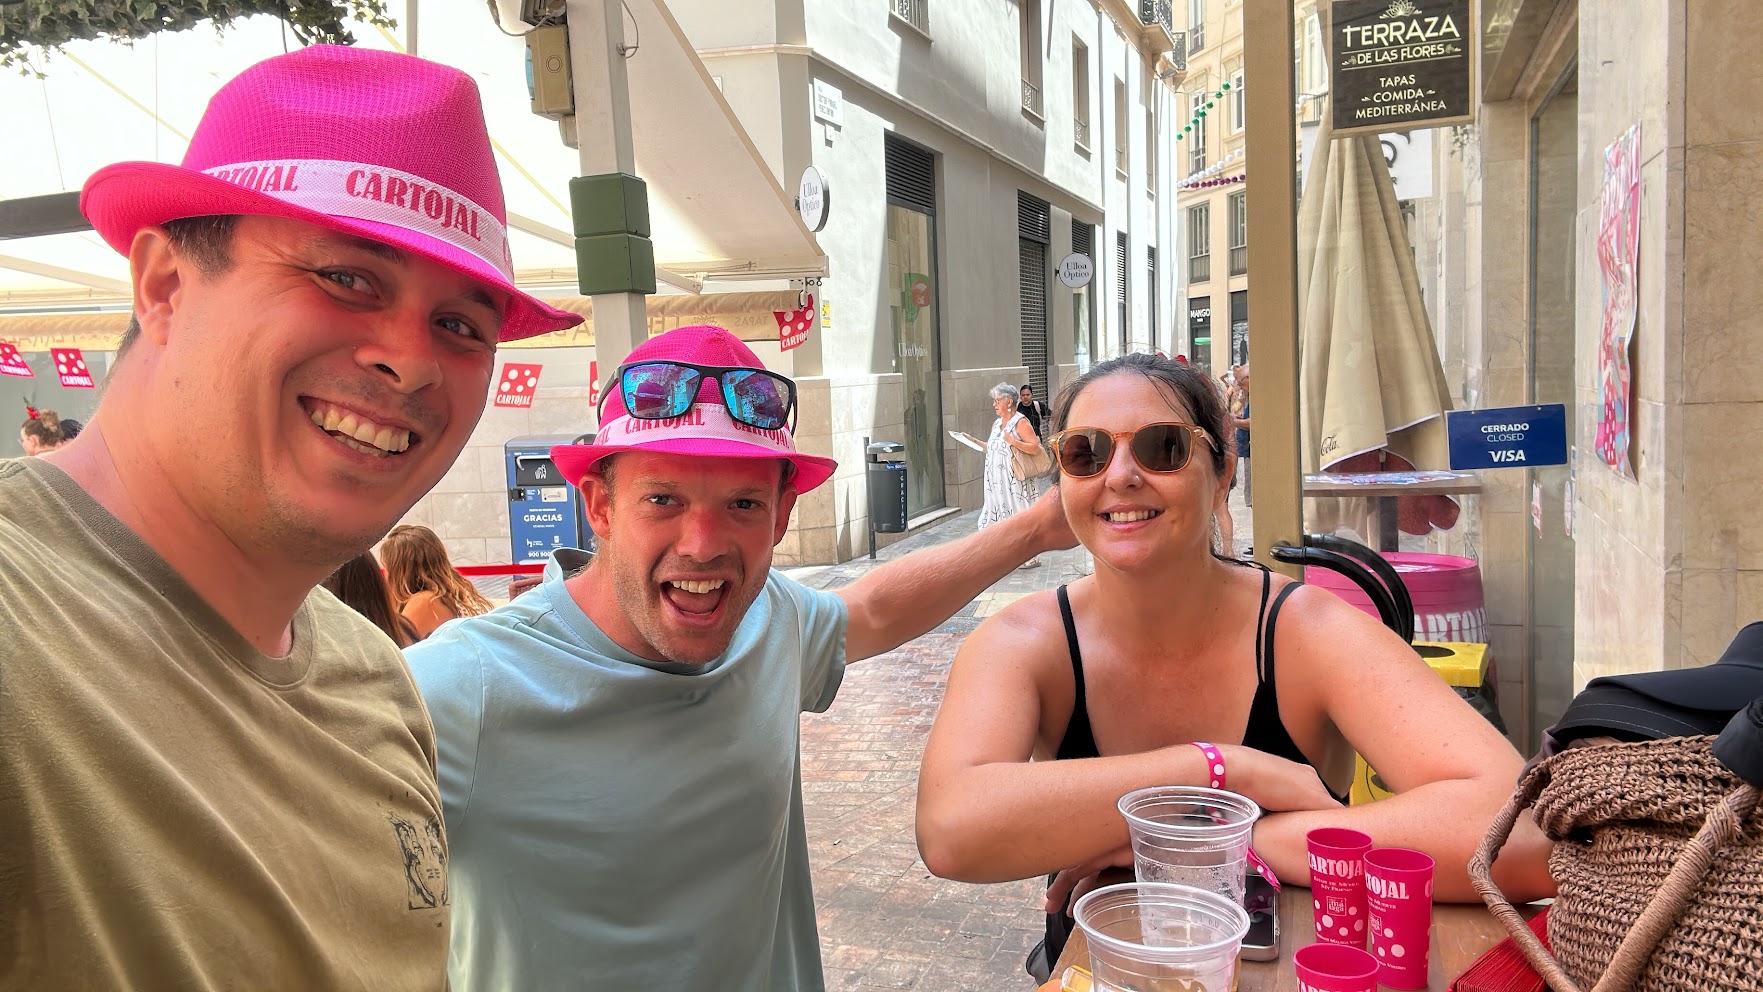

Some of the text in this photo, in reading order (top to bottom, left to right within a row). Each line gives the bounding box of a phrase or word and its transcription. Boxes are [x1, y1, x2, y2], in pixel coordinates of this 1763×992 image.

[1342, 14, 1460, 48] TERRAZA
[1357, 43, 1445, 65] DE LAS FLORES
[1379, 74, 1416, 88] TAPAS
[1373, 88, 1425, 103] COMIDA
[1355, 100, 1447, 119] MEDITERRÁNEA
[346, 169, 481, 242] CARTOJAL
[1066, 262, 1087, 270] Ulloa
[1190, 308, 1211, 318] MANGO
[496, 394, 532, 405] CARTOJAL
[1481, 423, 1530, 433] CERRADO
[1487, 433, 1525, 442] CLOSED
[1488, 449, 1526, 462] VISA
[523, 514, 563, 522] GRACIAS
